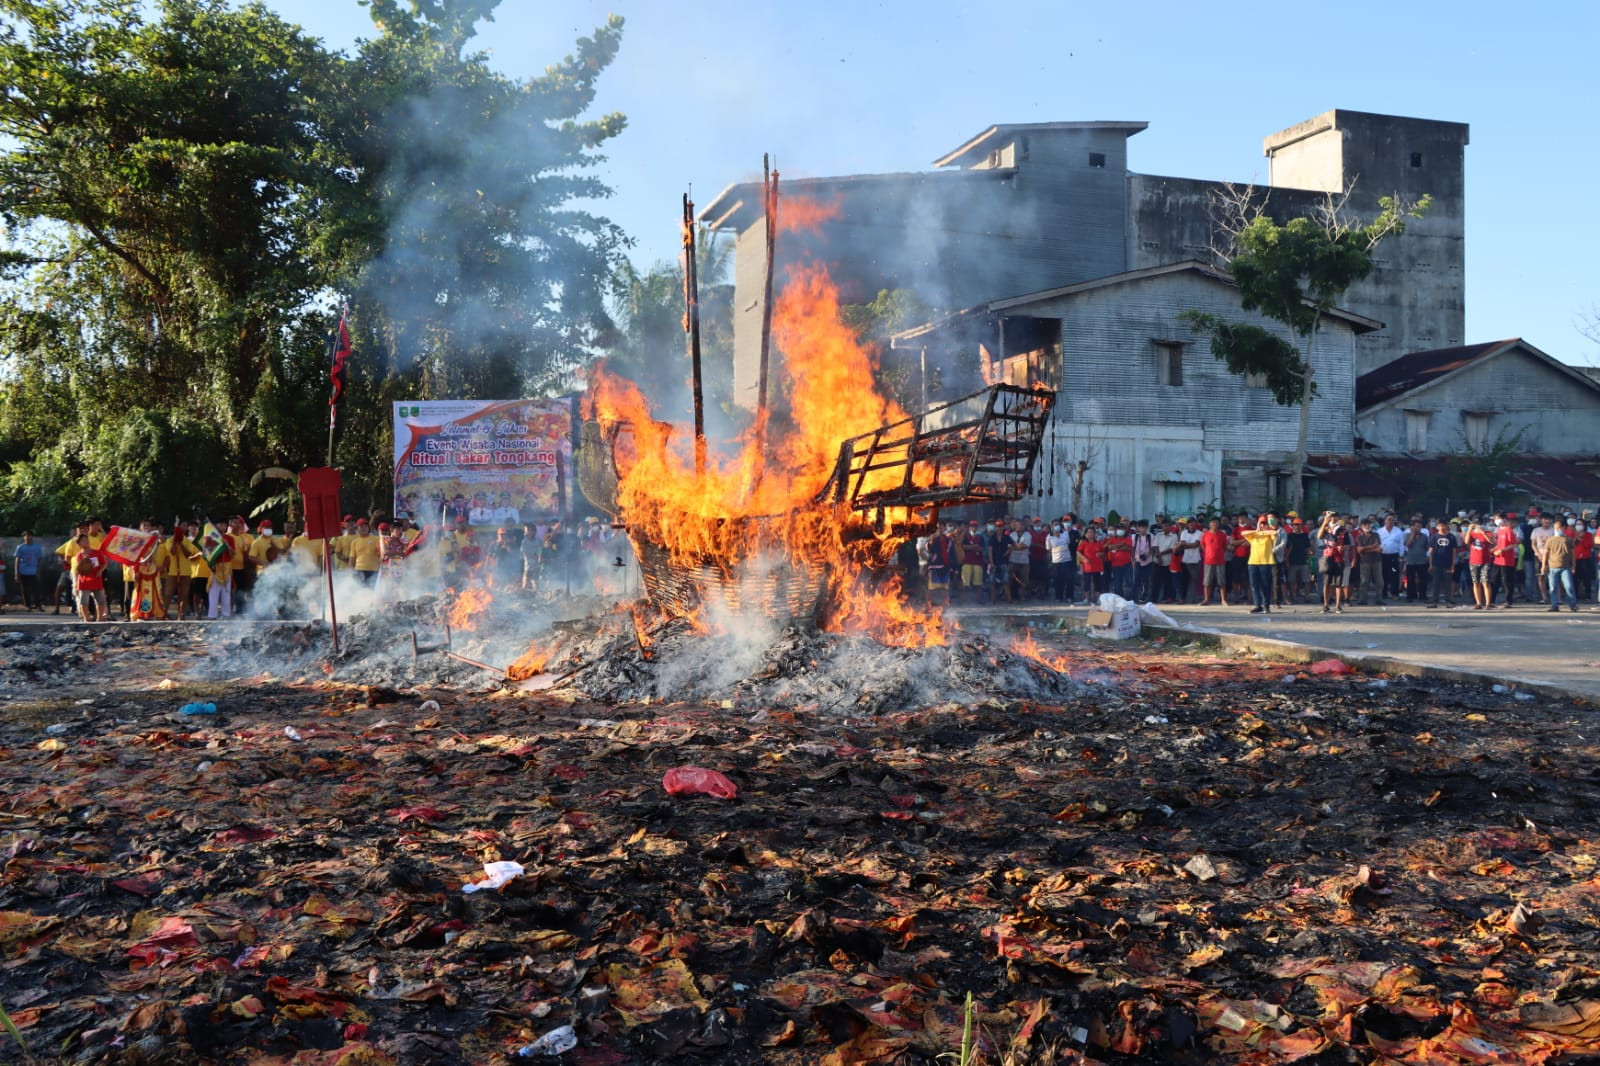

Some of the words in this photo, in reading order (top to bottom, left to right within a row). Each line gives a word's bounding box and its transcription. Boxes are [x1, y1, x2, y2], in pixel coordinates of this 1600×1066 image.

[440, 423, 479, 435] Selamat
[496, 421, 528, 435] Sukses
[427, 440, 456, 449] Event
[460, 440, 495, 449] Wisata
[498, 439, 540, 449] Nasional
[412, 452, 450, 465] Ritual
[454, 452, 490, 465] Bakar
[494, 452, 555, 465] Tongkang
